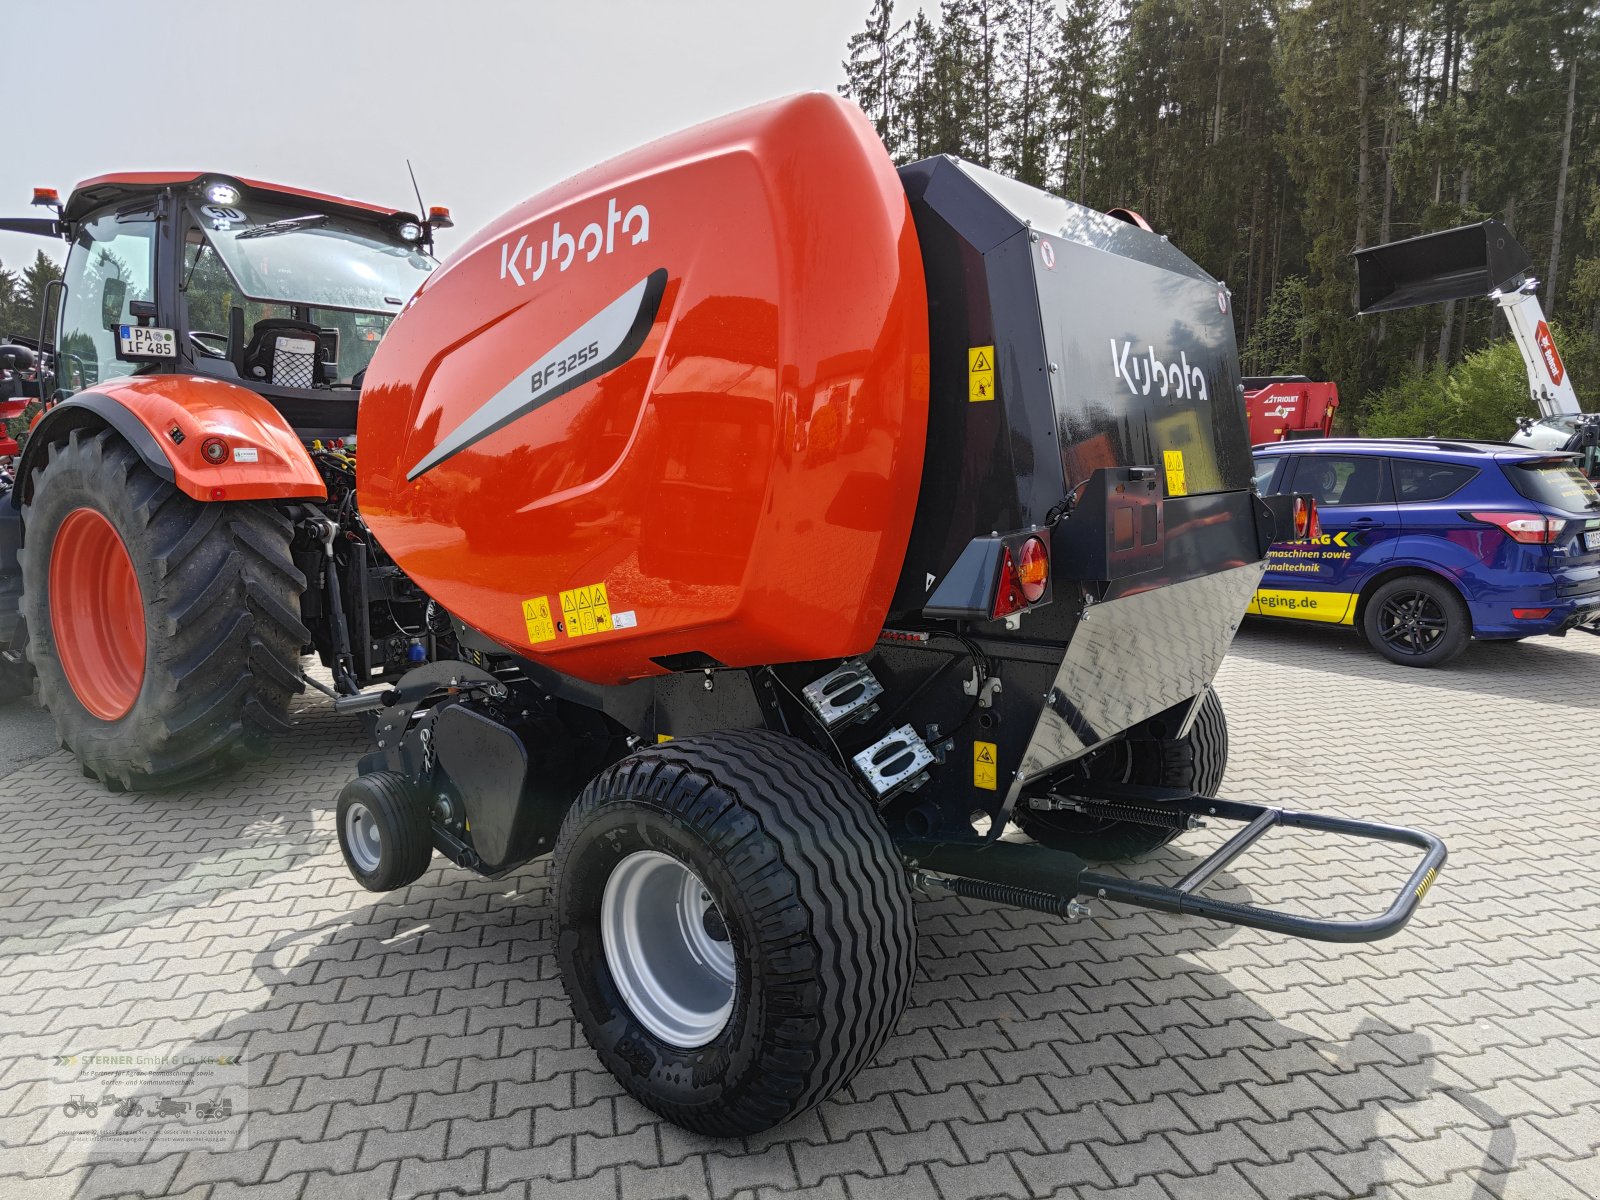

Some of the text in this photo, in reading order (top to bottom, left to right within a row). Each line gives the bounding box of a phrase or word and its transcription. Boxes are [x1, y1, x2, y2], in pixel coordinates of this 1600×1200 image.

[207, 206, 240, 219] 50
[499, 197, 650, 287] Kubota
[134, 329, 153, 342] PA
[127, 341, 172, 355] IF 485
[530, 340, 599, 393] BF3255
[1110, 338, 1208, 401] Kubota
[1544, 348, 1560, 377] Bobcat
[1321, 549, 1351, 560] sowie
